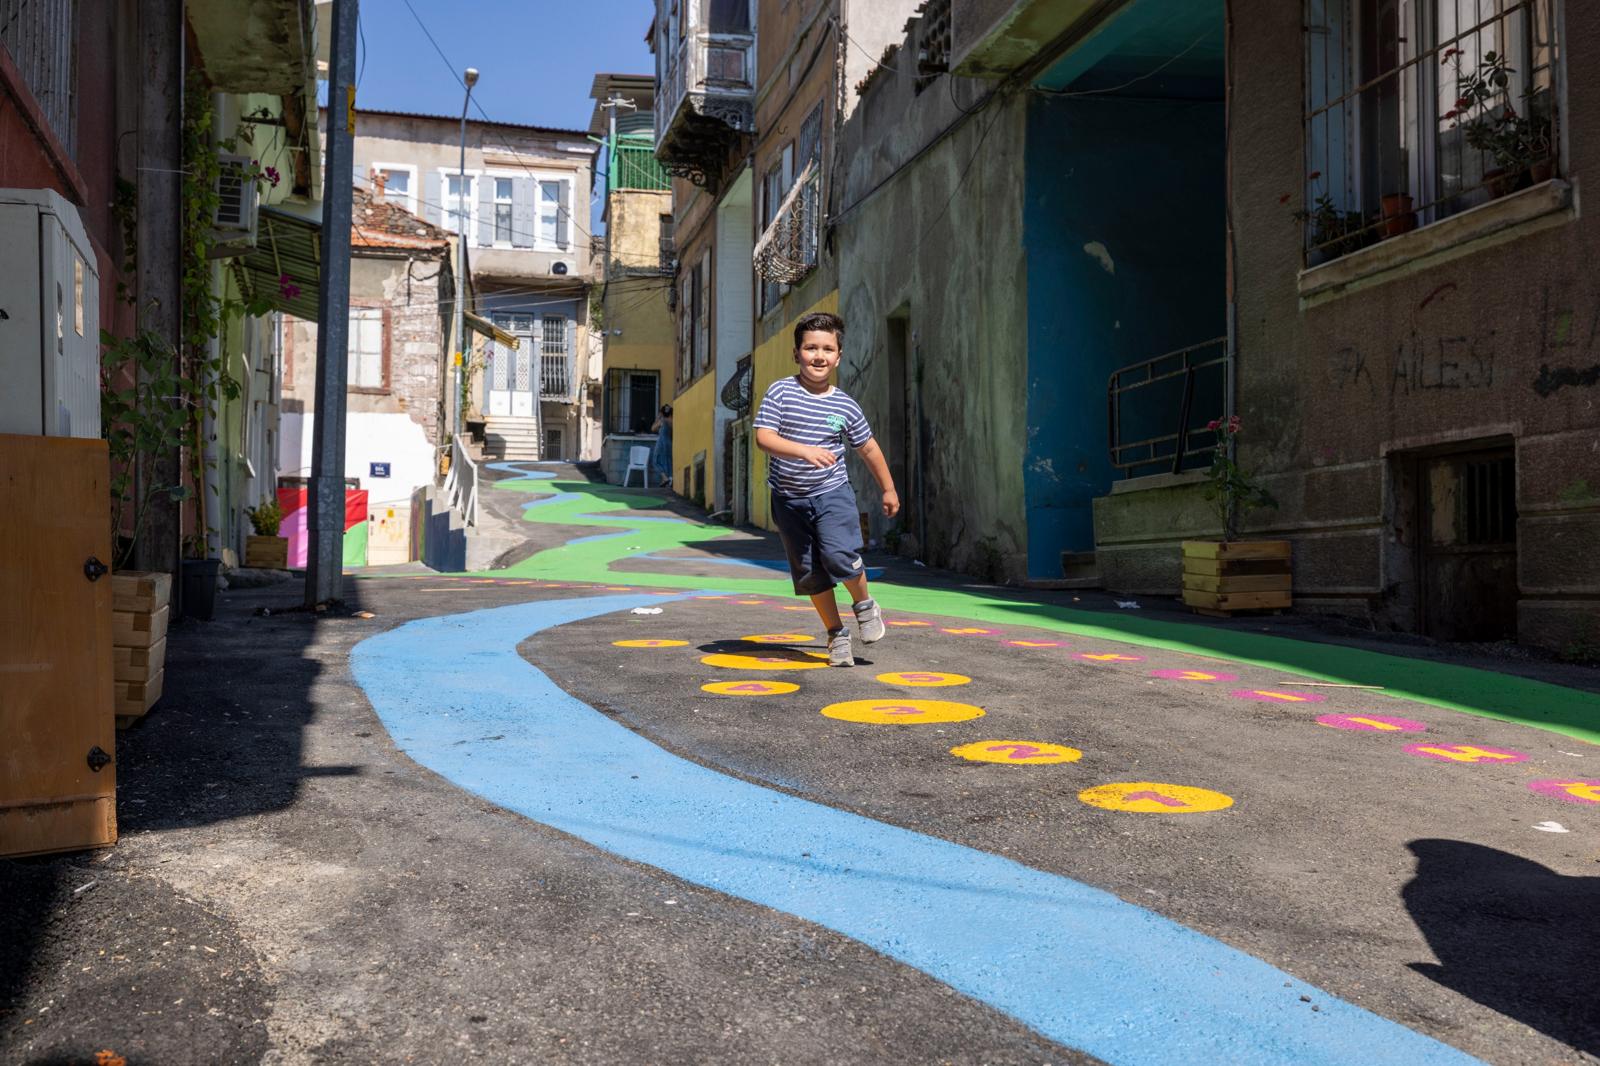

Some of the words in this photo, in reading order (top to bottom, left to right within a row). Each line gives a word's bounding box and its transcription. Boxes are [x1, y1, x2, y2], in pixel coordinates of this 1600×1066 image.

[898, 673, 945, 683] 5
[726, 683, 772, 692] 4
[872, 705, 926, 715] 3
[986, 744, 1060, 759] 2
